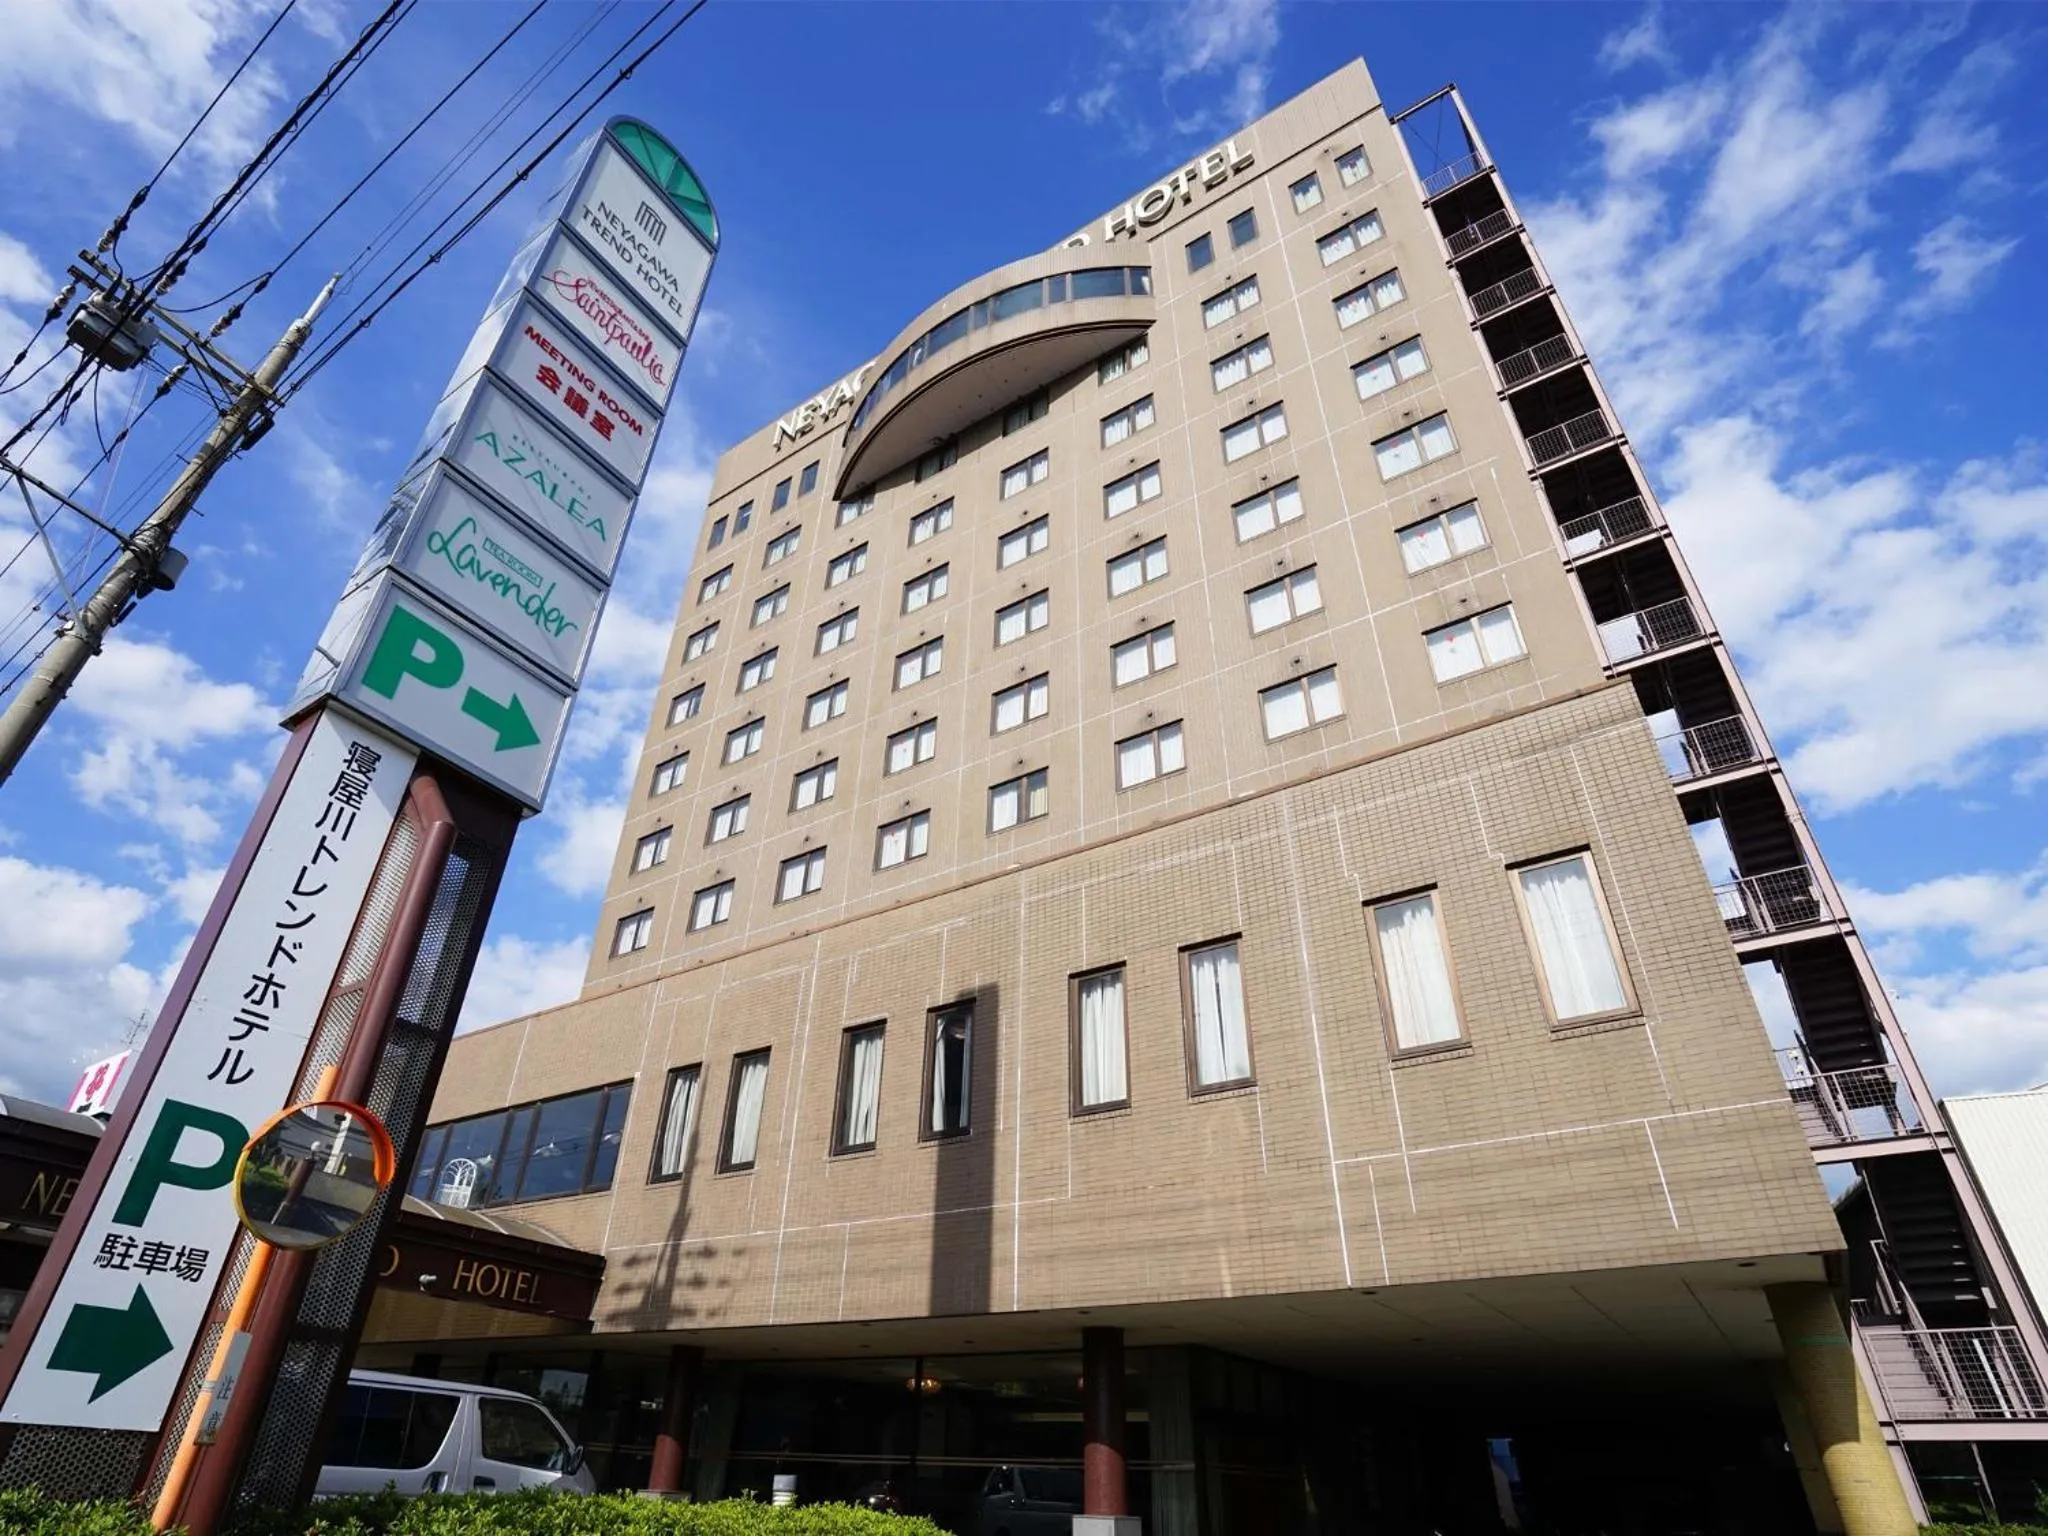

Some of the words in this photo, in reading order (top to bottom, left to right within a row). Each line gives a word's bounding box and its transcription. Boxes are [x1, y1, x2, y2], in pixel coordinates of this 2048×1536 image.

[598, 201, 678, 292] NEYAGAWA
[1104, 140, 1255, 244] HOTEL
[583, 204, 633, 263] TREND
[636, 263, 682, 317] HOTEL
[524, 325, 596, 393] MEETING
[598, 389, 643, 436] ROOM
[540, 269, 666, 387] Saintpaulia
[536, 365, 615, 441] 会議室
[475, 431, 605, 542] AZALEA
[427, 517, 578, 637] Lavender
[362, 604, 465, 700] P
[207, 741, 382, 1085] 寝屋川トレンドホテル
[112, 1098, 250, 1228] P
[93, 1232, 209, 1283] 駐車場
[452, 1259, 542, 1304] HOTEL
